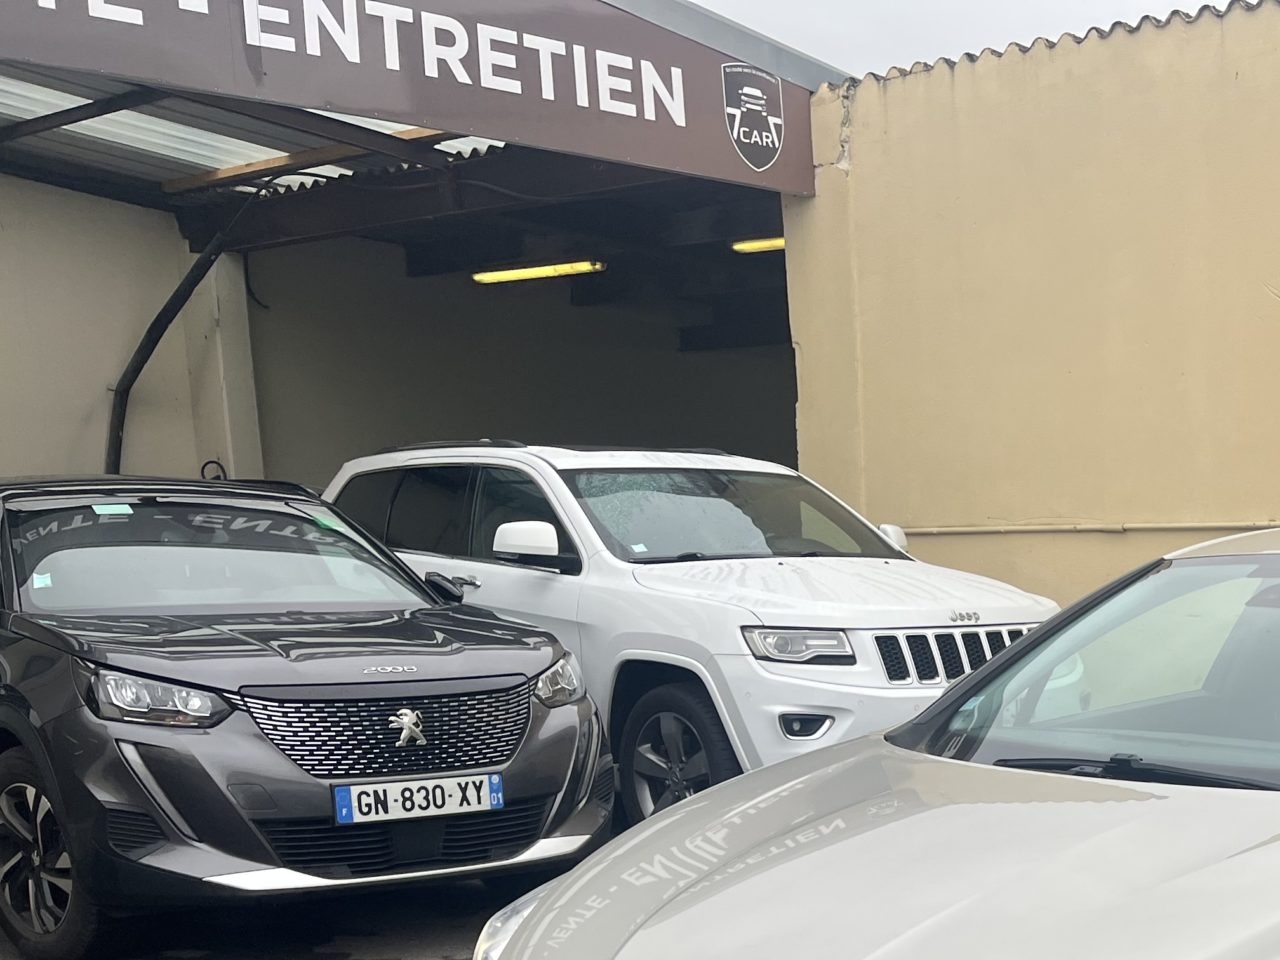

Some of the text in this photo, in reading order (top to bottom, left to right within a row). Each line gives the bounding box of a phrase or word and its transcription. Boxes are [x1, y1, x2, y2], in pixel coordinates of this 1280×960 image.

[243, 0, 687, 128] ENTRETIEN
[949, 609, 981, 624] Jeep
[363, 665, 418, 674] 2008
[490, 792, 503, 805] 01
